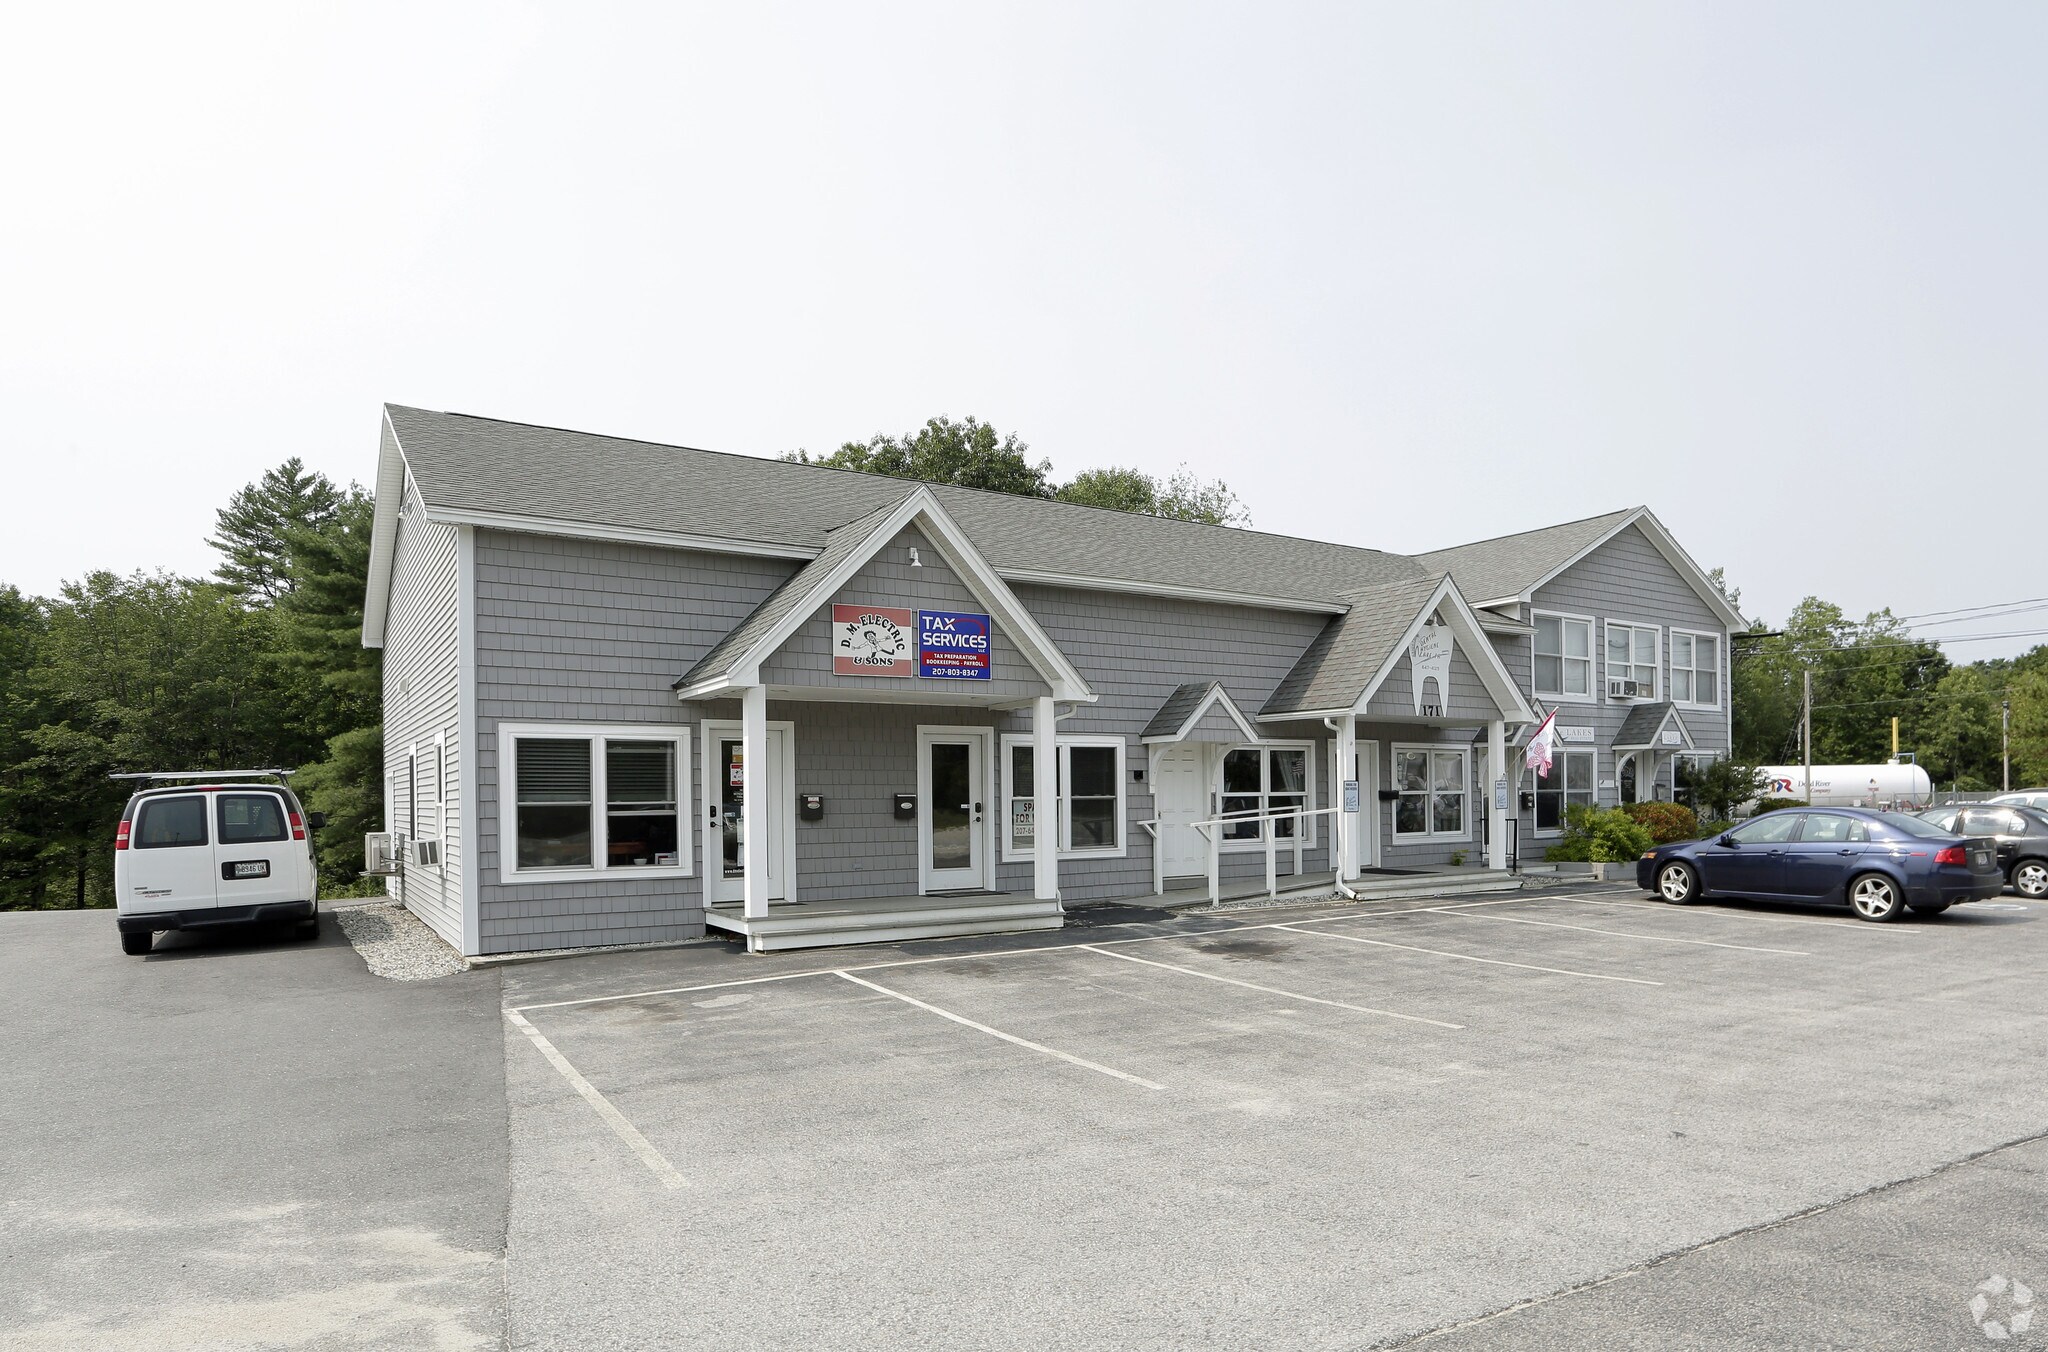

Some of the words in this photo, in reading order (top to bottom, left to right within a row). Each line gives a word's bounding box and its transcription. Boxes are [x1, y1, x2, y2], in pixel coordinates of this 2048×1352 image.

[922, 616, 956, 631] TAX
[846, 623, 860, 635] M.
[859, 614, 905, 650] ELECTRIC
[922, 632, 987, 648] SERVICES
[853, 656, 863, 664] &
[865, 656, 893, 665] SONS
[932, 668, 979, 676] 207-803-8347
[1423, 705, 1441, 716] 171
[1016, 814, 1030, 823] FOR
